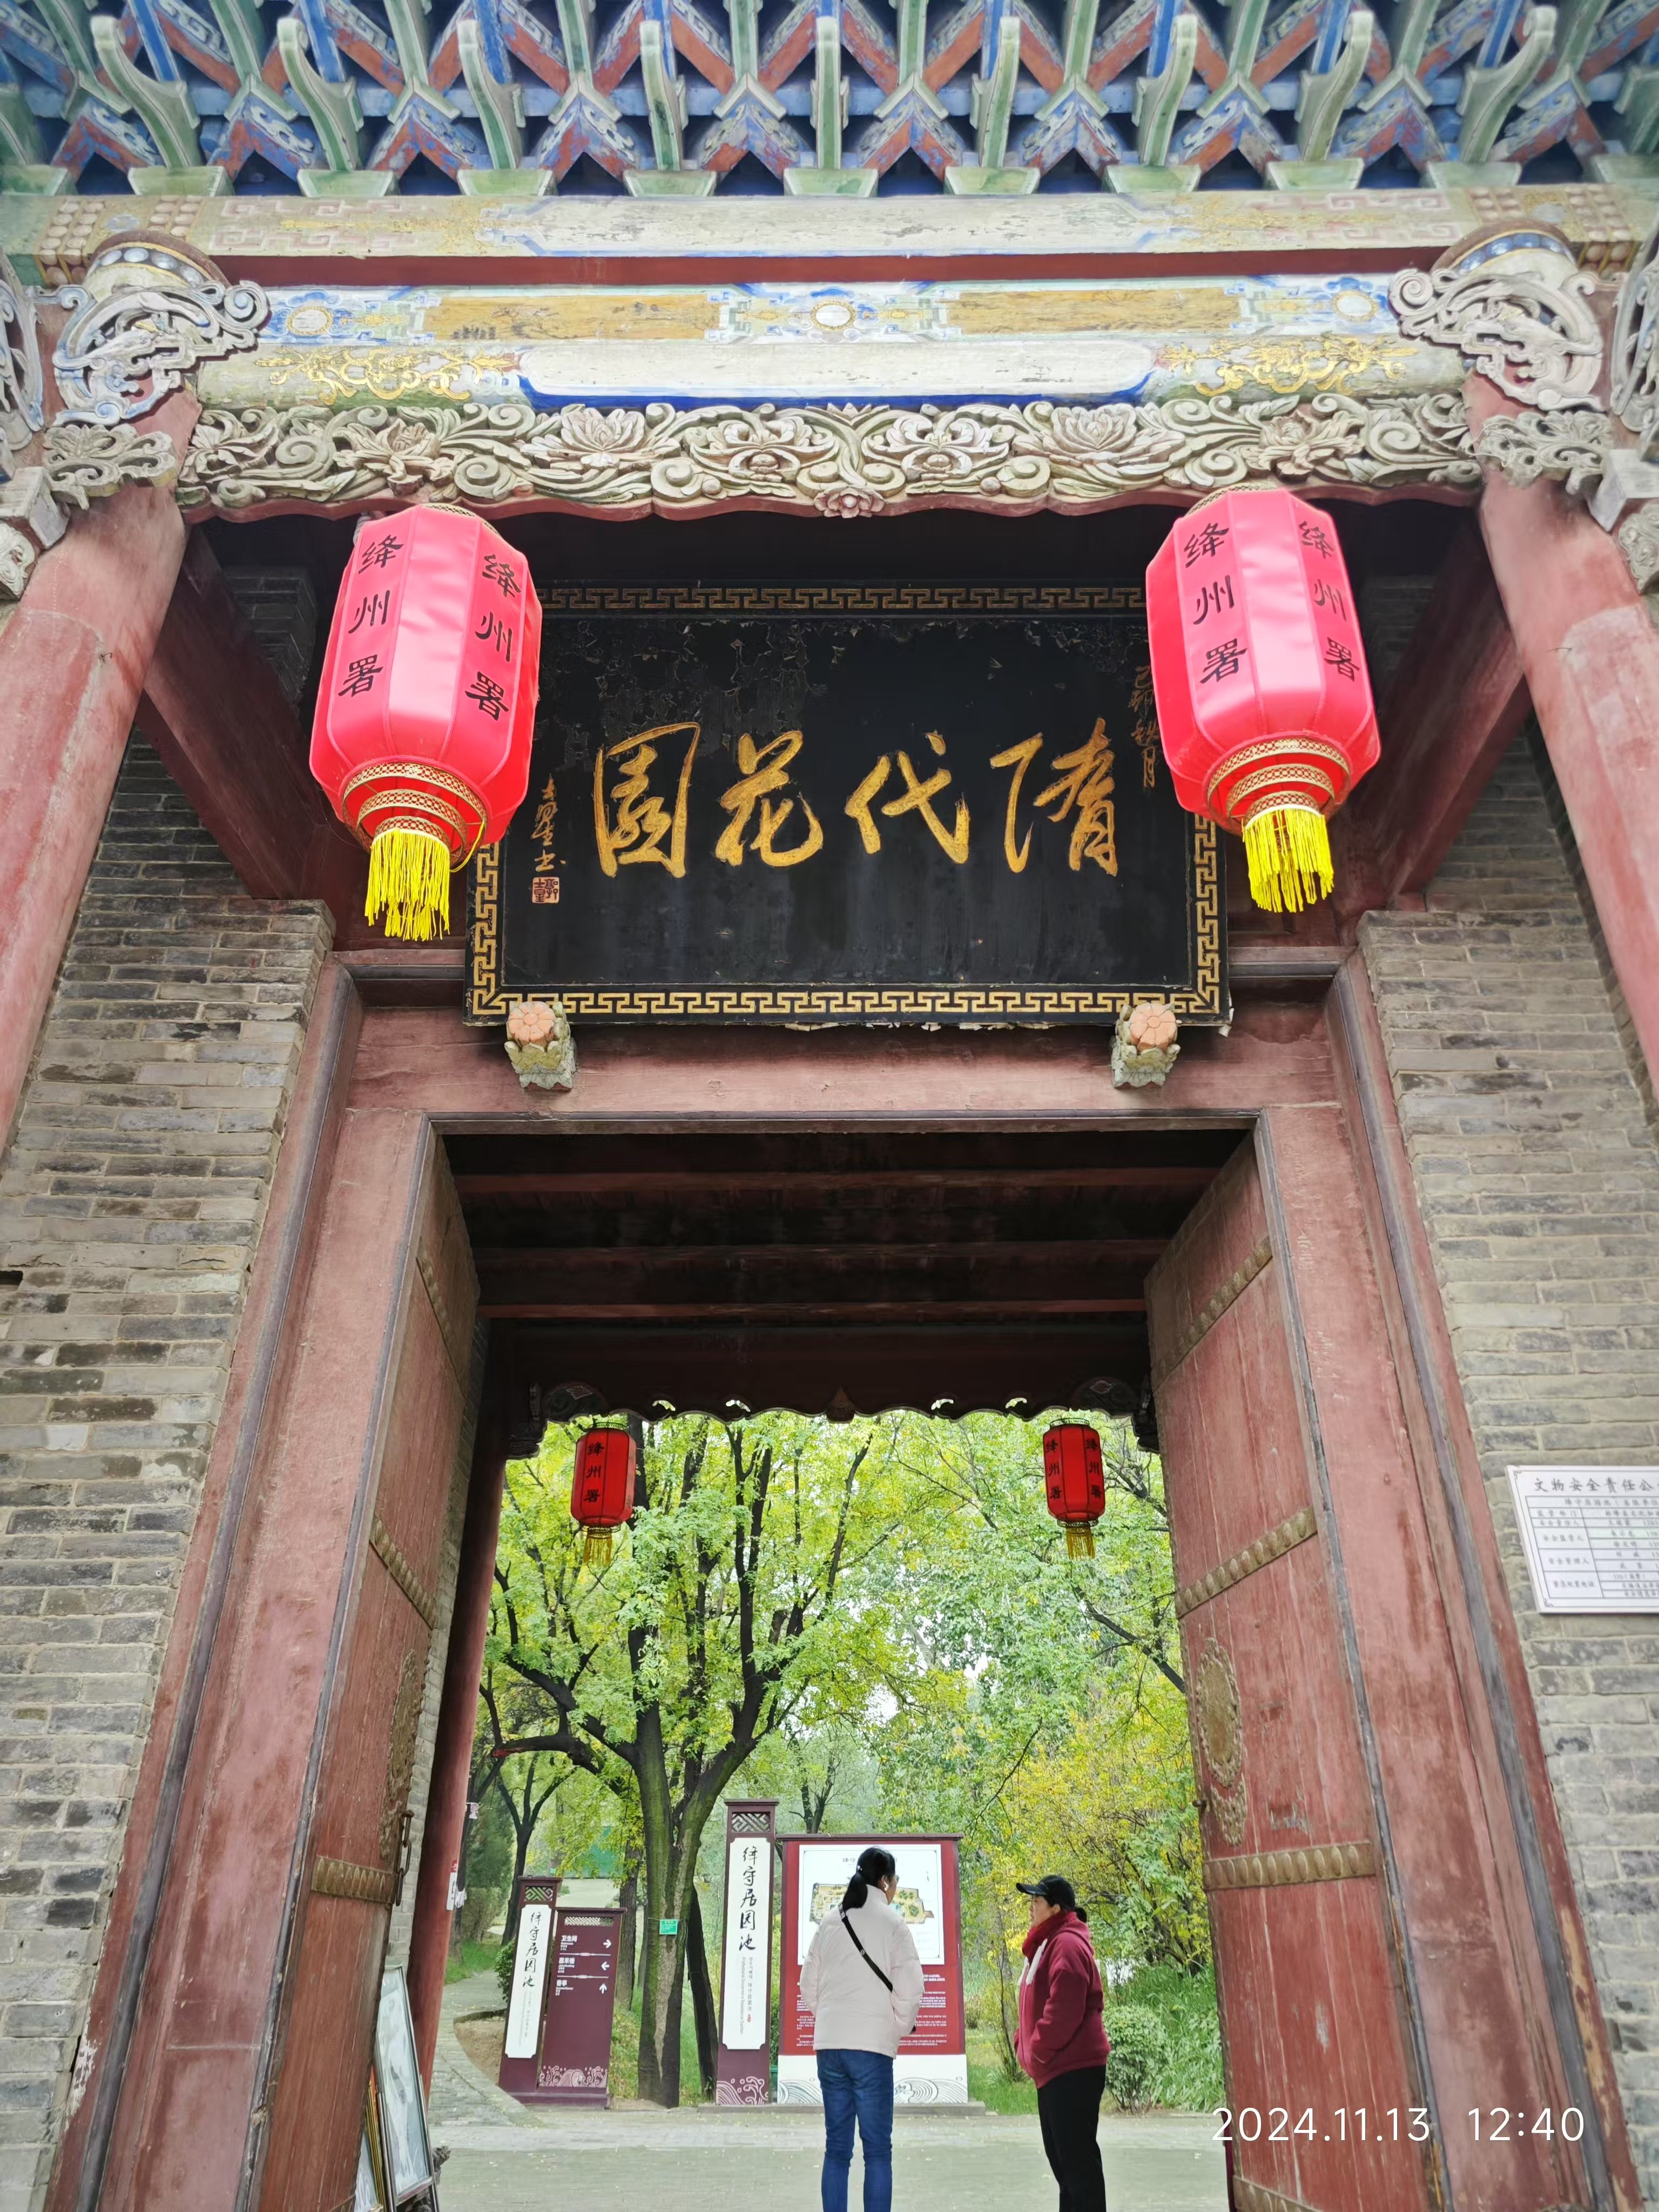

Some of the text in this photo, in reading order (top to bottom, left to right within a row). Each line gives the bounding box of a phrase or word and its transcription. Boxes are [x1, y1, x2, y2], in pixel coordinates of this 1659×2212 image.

[338, 534, 404, 698] 绛州署
[464, 554, 522, 721] 绛州署
[1184, 522, 1247, 685] 绛州署
[1298, 520, 1360, 682] 绛州署
[583, 1441, 605, 1503] 绛州署
[1046, 1438, 1062, 1500] 绛州署
[1534, 1476, 1659, 1493] 文物安全责任公
